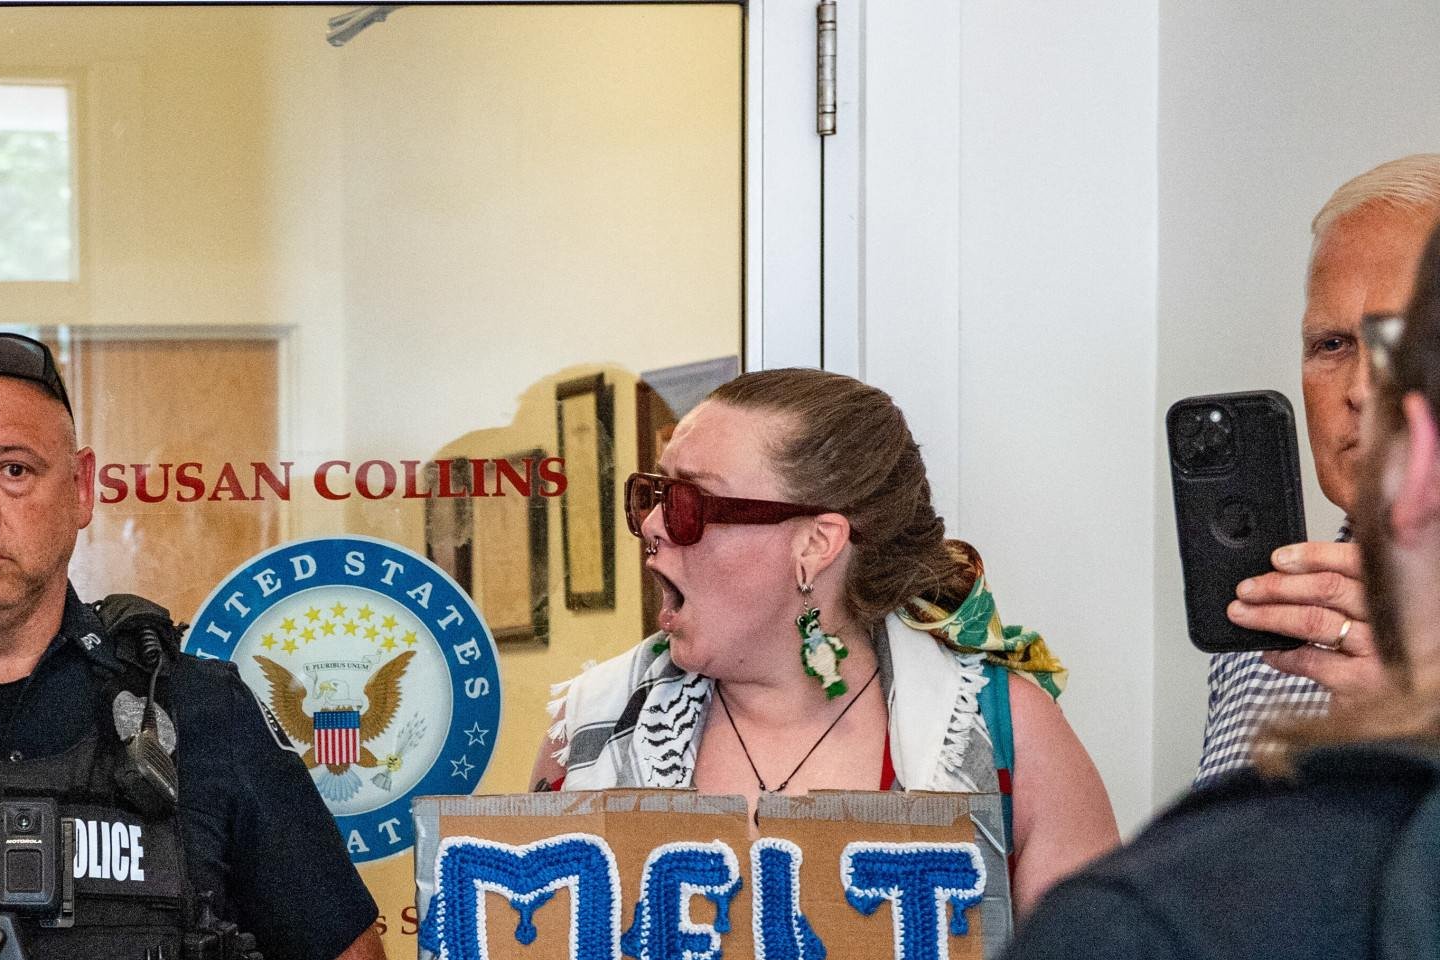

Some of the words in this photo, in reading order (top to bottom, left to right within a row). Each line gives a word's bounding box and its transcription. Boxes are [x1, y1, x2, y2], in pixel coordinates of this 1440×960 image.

[97, 460, 295, 505] SUSAN
[313, 456, 569, 500] COLLINS
[195, 554, 318, 660] ITED
[344, 550, 491, 700] STATES
[73, 818, 145, 882] OLICE
